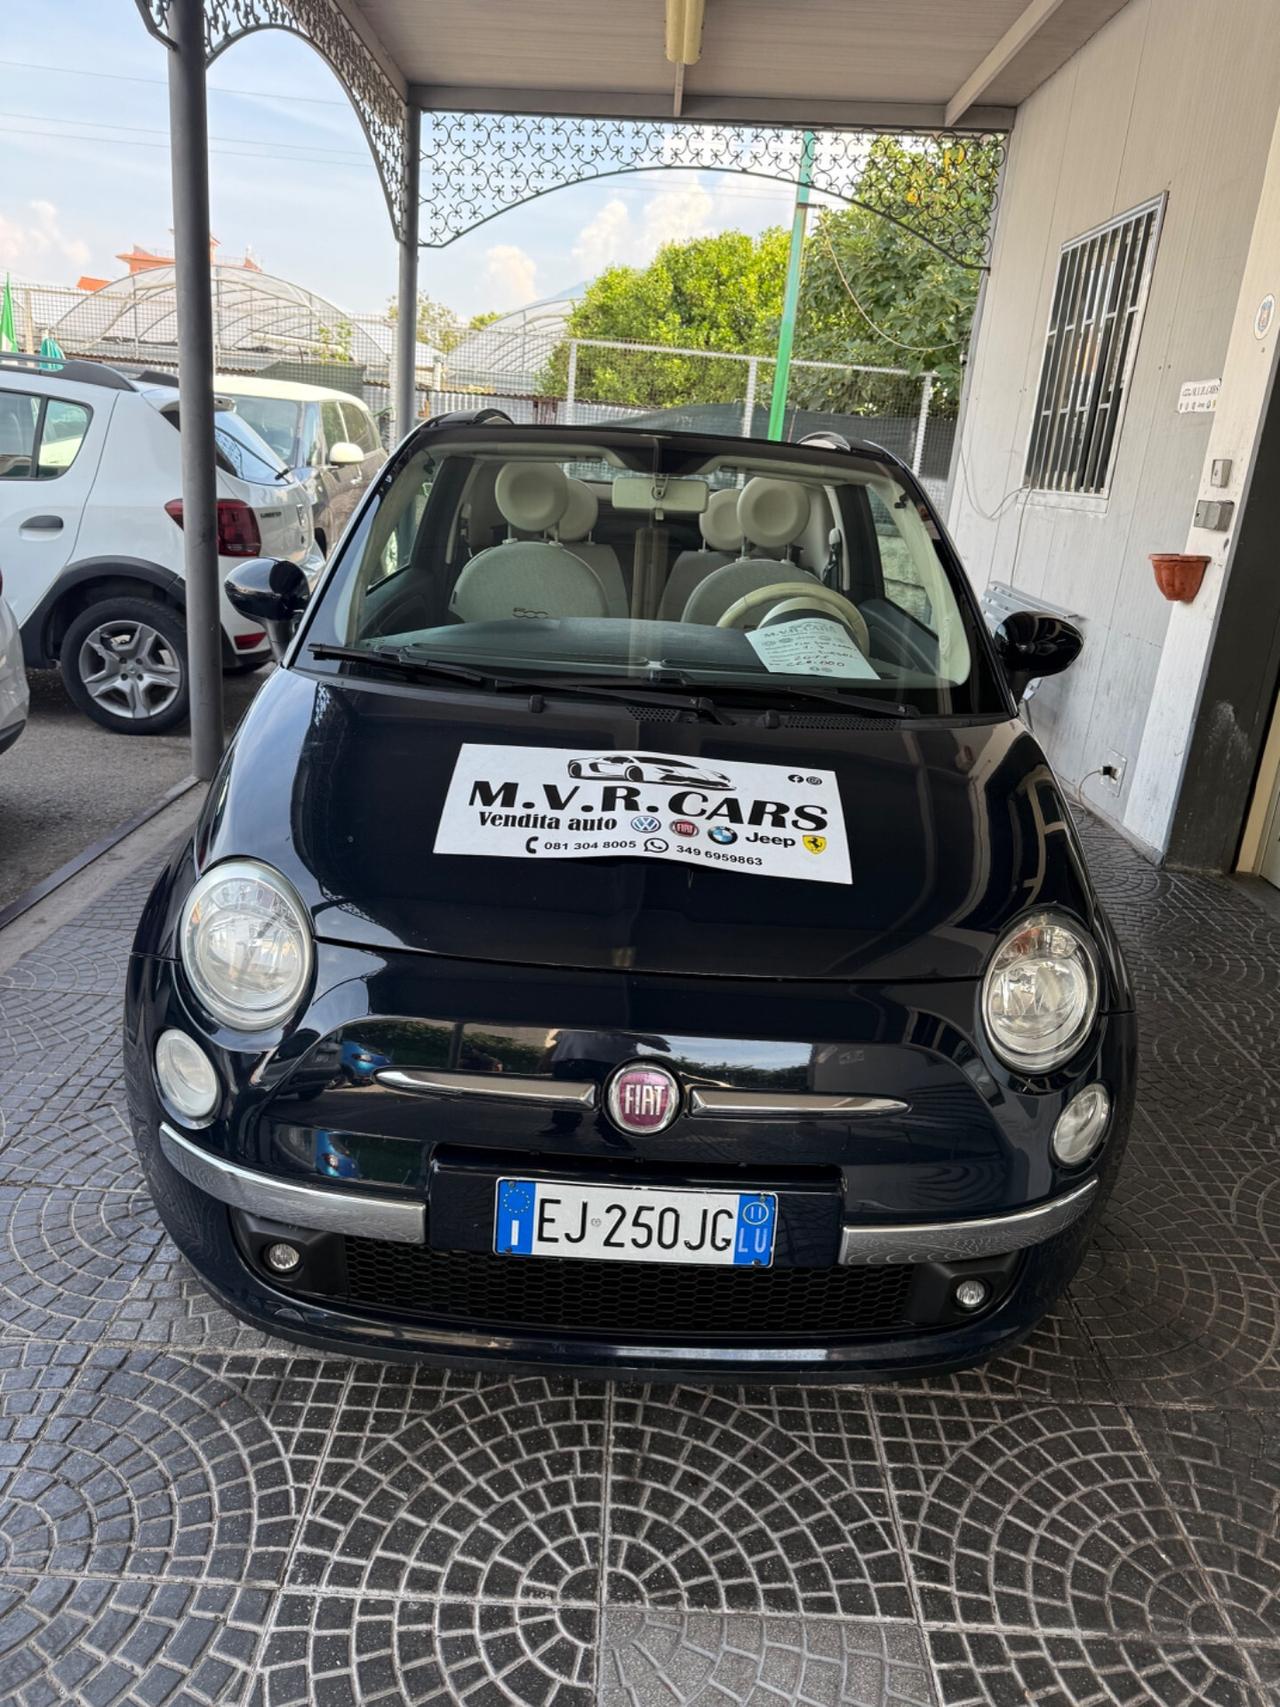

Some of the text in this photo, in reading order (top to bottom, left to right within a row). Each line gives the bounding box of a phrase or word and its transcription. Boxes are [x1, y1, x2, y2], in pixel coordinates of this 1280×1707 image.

[478, 811, 617, 832] Vendita auto
[544, 840, 637, 851] 081 304 8005
[744, 832, 796, 849] Jeep
[676, 845, 763, 867] 349 6959863
[624, 1083, 665, 1116] FIAT
[510, 1219, 519, 1246] I
[537, 1198, 588, 1243] EJ
[737, 1227, 768, 1253] LU
